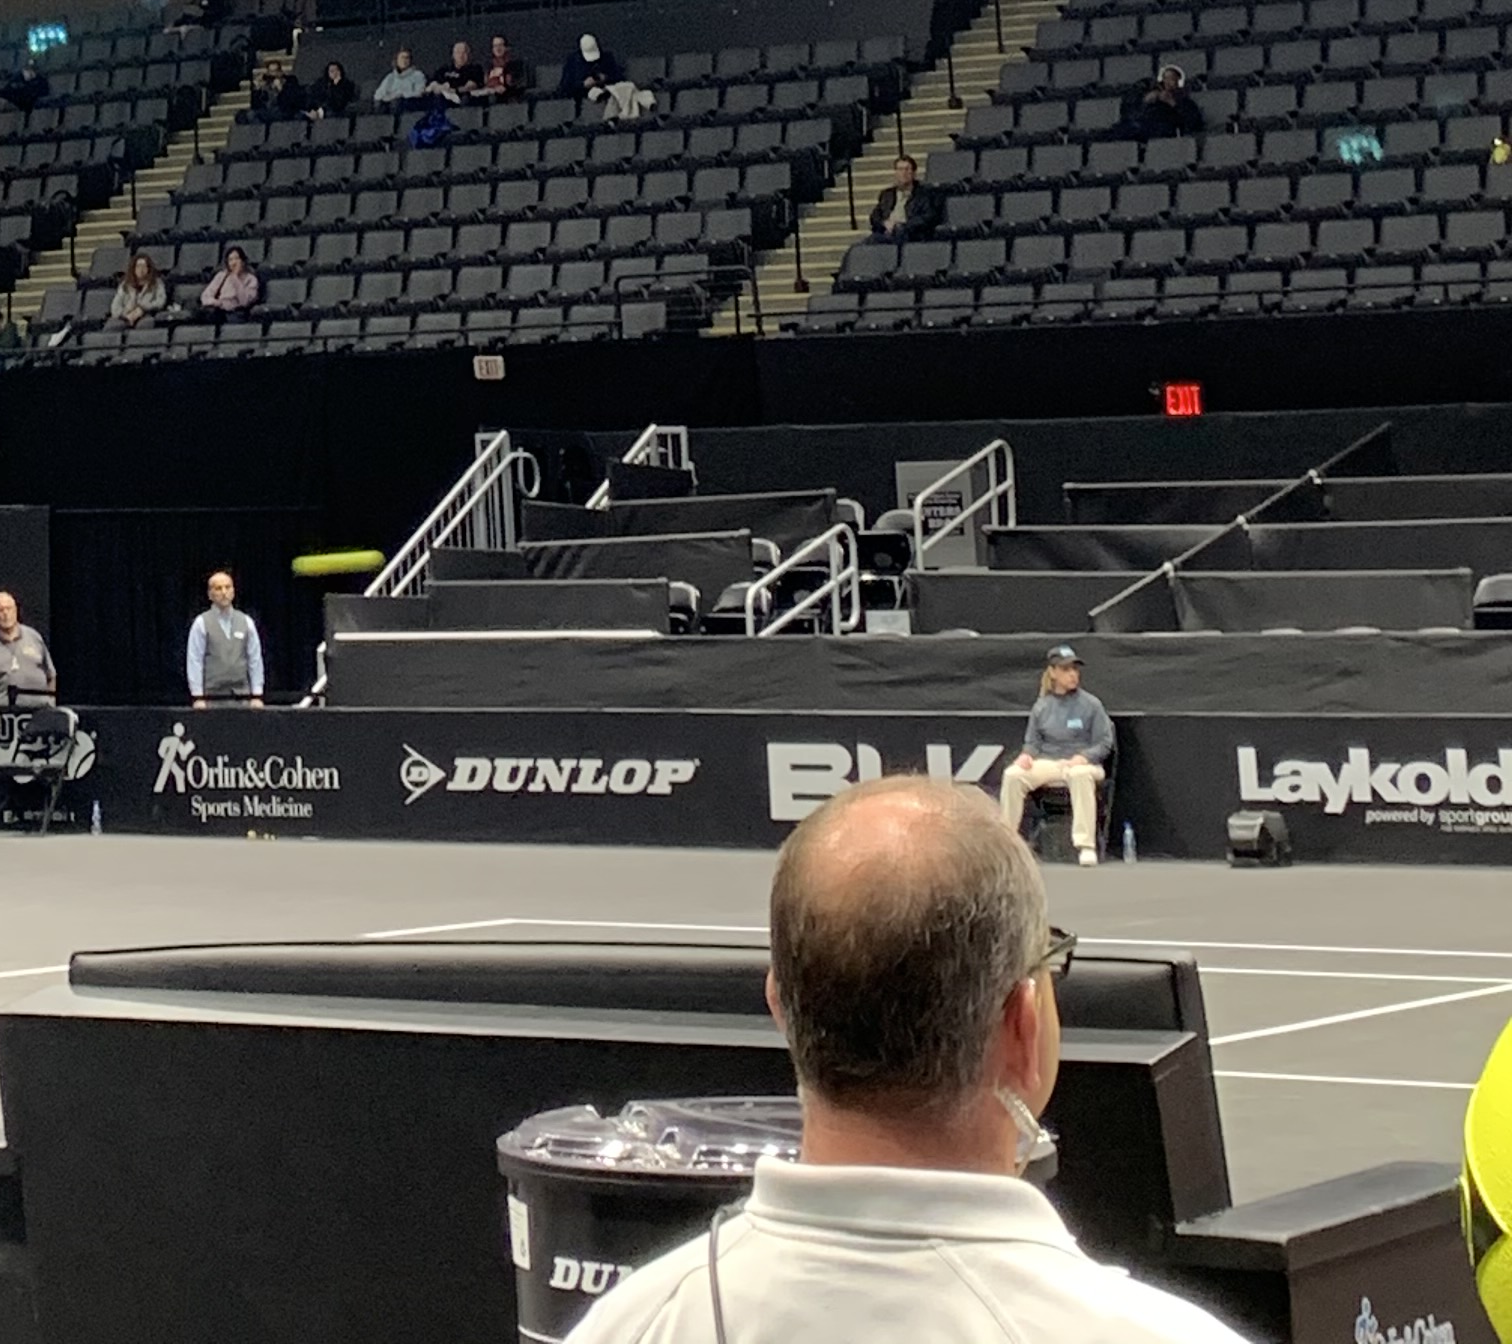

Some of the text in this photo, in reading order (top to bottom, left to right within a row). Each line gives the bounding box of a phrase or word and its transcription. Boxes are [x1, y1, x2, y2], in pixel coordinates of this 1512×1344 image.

[1165, 384, 1202, 416] EXIT
[187, 754, 340, 790] Orlin&Cohen
[446, 757, 697, 795] DUNLOP
[1237, 746, 1512, 814] Laykold
[191, 795, 314, 822] Sports Medicine
[1364, 809, 1418, 824] powered
[1419, 808, 1436, 825] by
